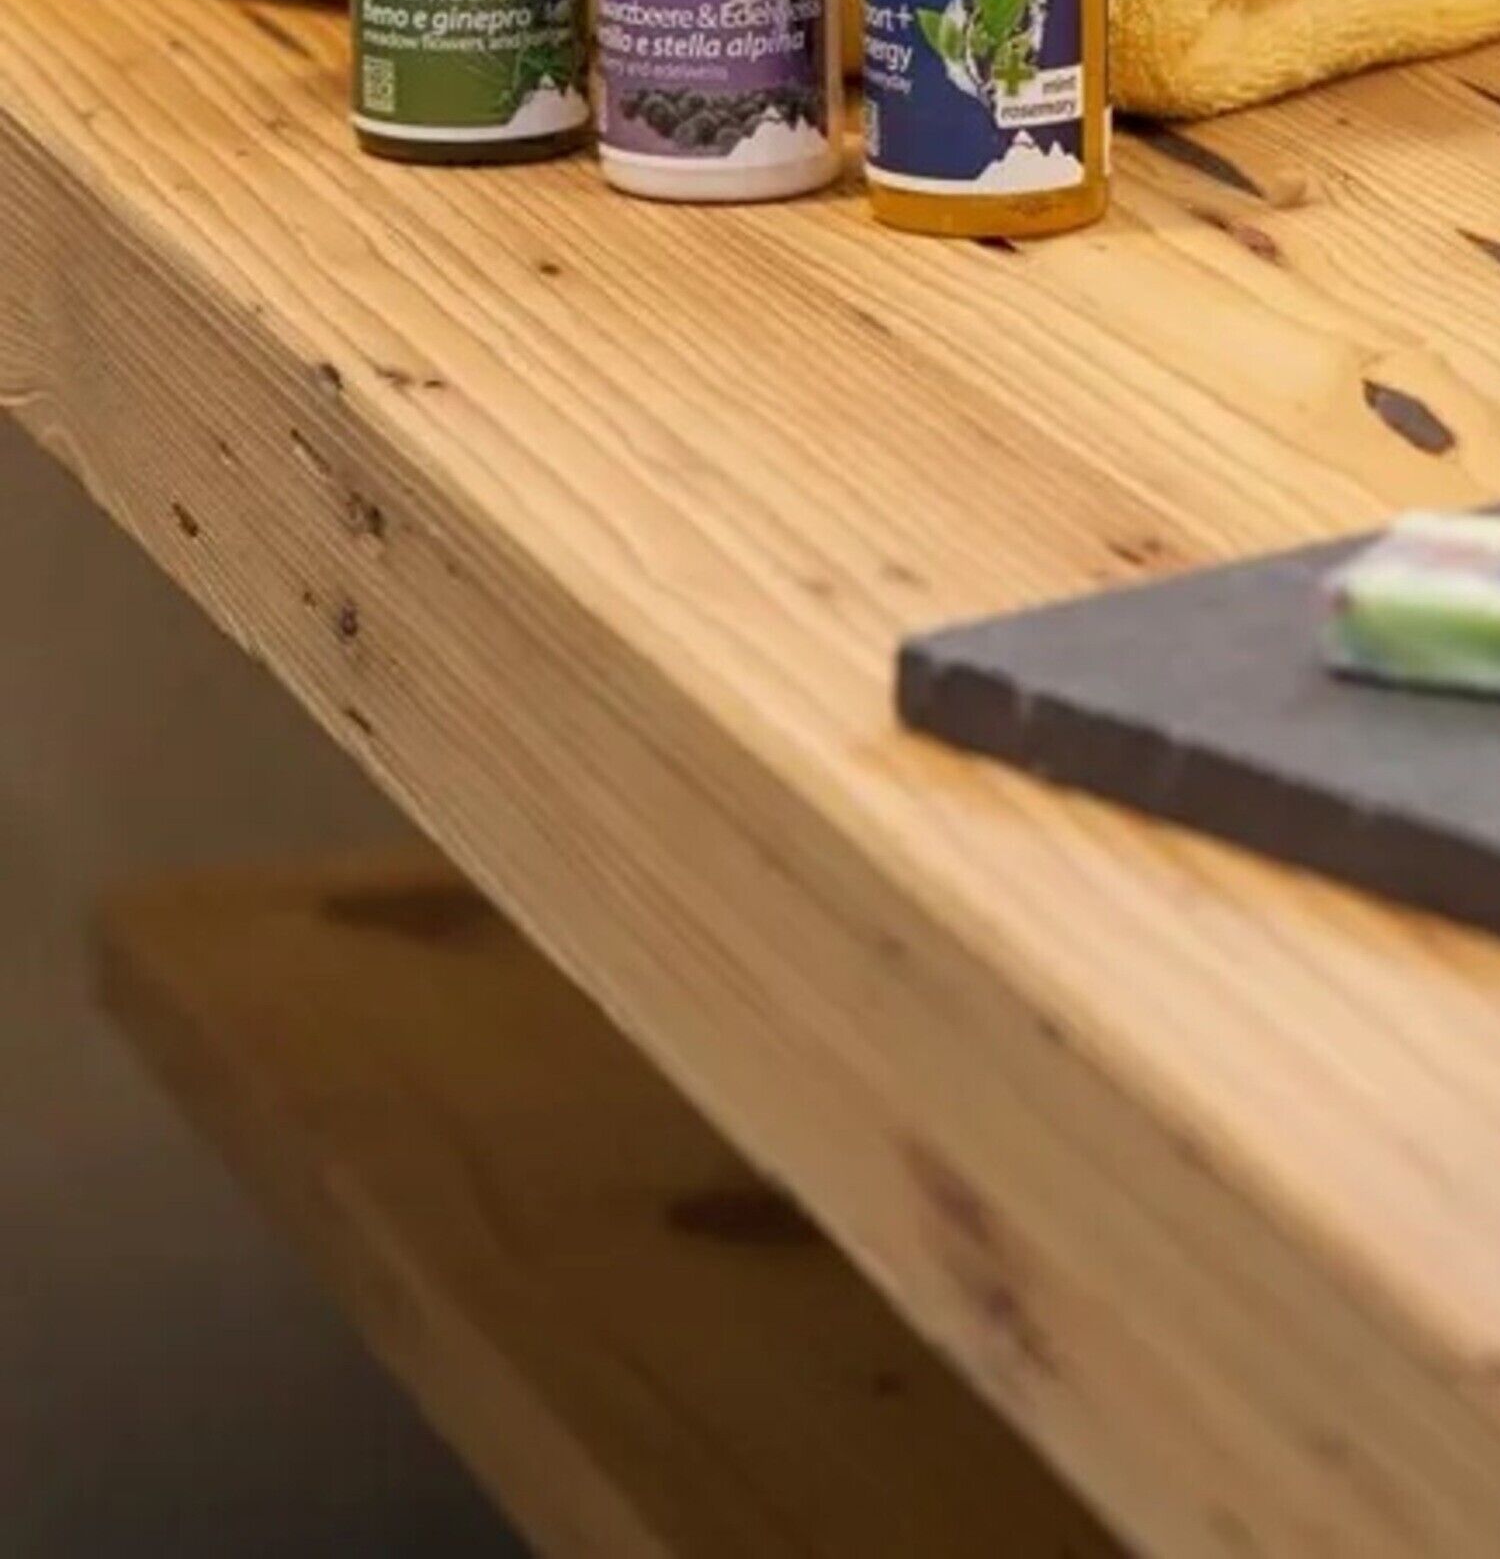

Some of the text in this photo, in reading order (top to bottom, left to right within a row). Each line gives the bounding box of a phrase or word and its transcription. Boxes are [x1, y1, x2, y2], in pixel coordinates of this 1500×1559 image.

[411, 9, 428, 29] e
[431, 5, 533, 36] ginepro
[697, 2, 718, 30] &
[636, 36, 650, 56] e
[652, 32, 722, 58] stella
